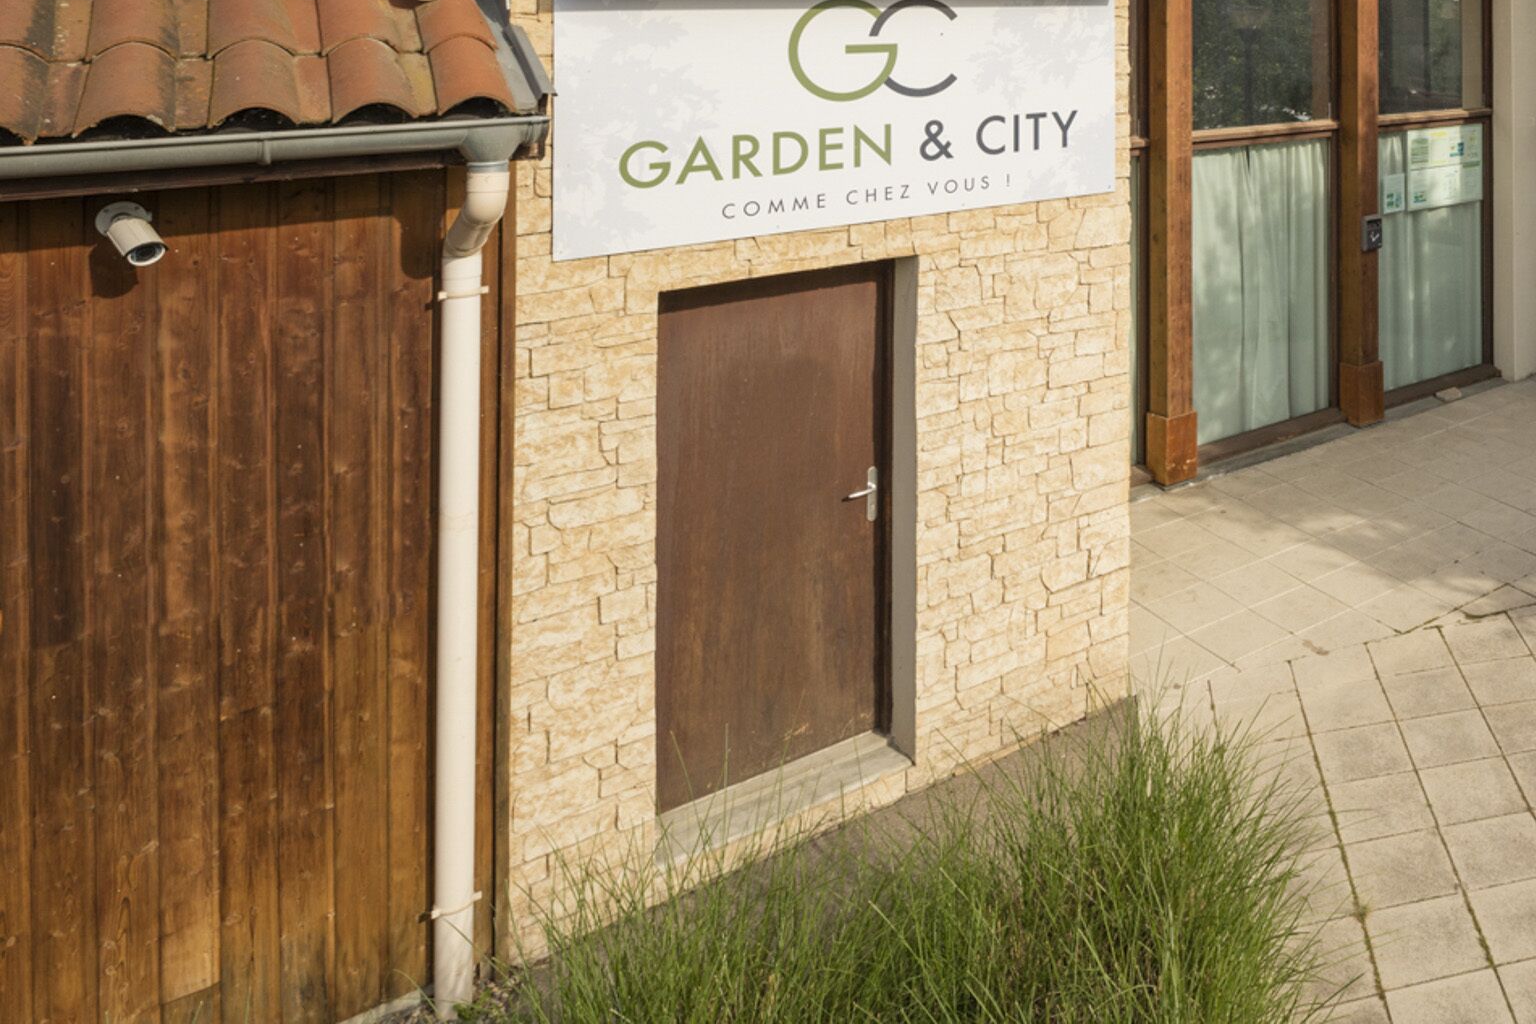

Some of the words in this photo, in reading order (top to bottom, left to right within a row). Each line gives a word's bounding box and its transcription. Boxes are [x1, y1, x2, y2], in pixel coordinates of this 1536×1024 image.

[618, 123, 893, 189] GARDEN
[919, 119, 953, 161] &
[975, 109, 1079, 156] CITY
[721, 192, 827, 220] COMME
[845, 183, 910, 205] CHEZ
[926, 175, 990, 198] VOUS
